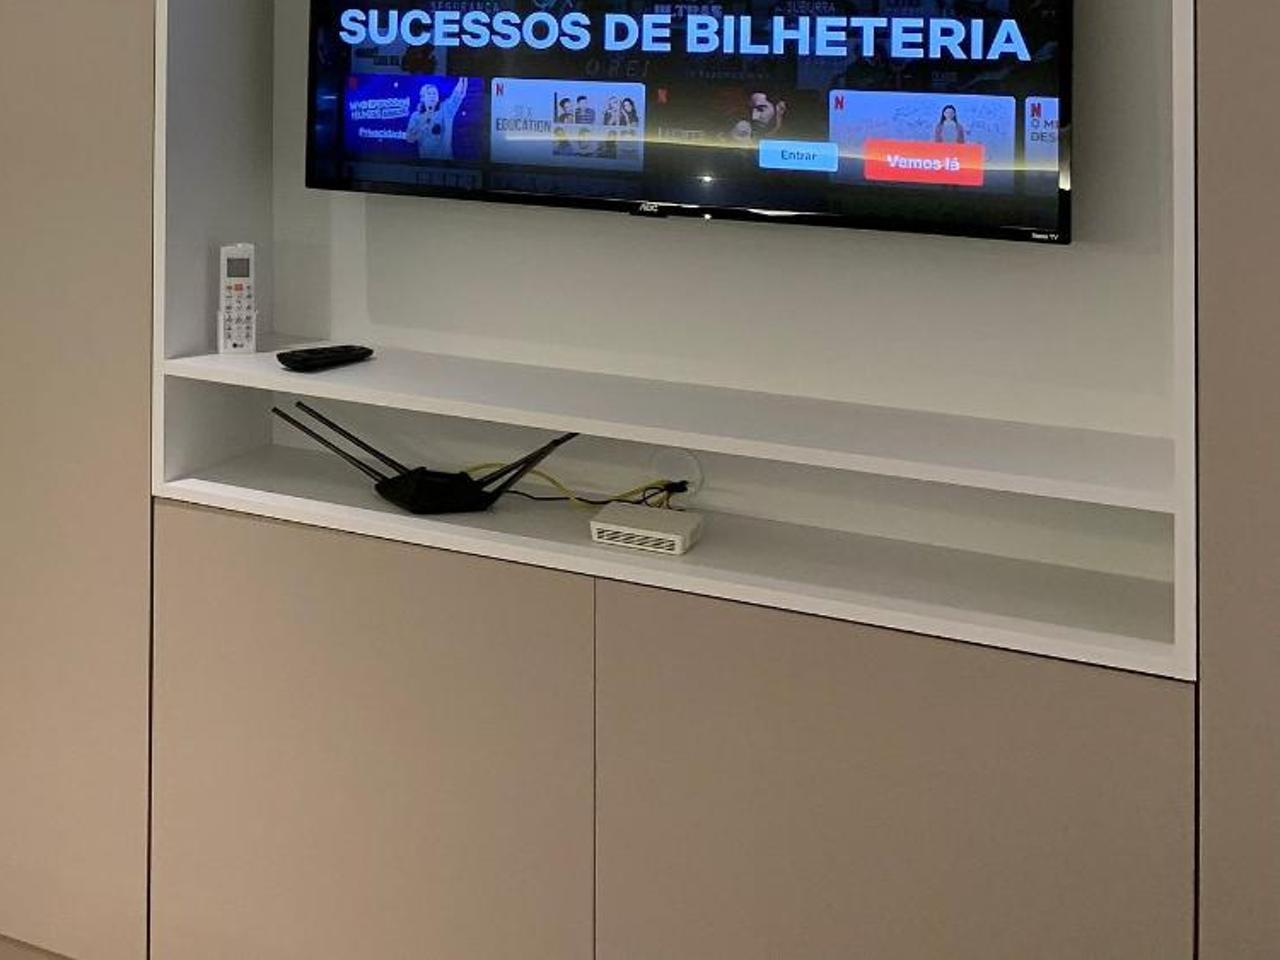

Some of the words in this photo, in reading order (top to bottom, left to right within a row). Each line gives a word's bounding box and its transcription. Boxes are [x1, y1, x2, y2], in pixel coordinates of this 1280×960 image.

[339, 8, 591, 50] SUCESSOS
[604, 13, 672, 52] DE
[686, 14, 1032, 61] BILHETERIA
[780, 149, 818, 162] Entrar
[886, 154, 941, 171] Vamos
